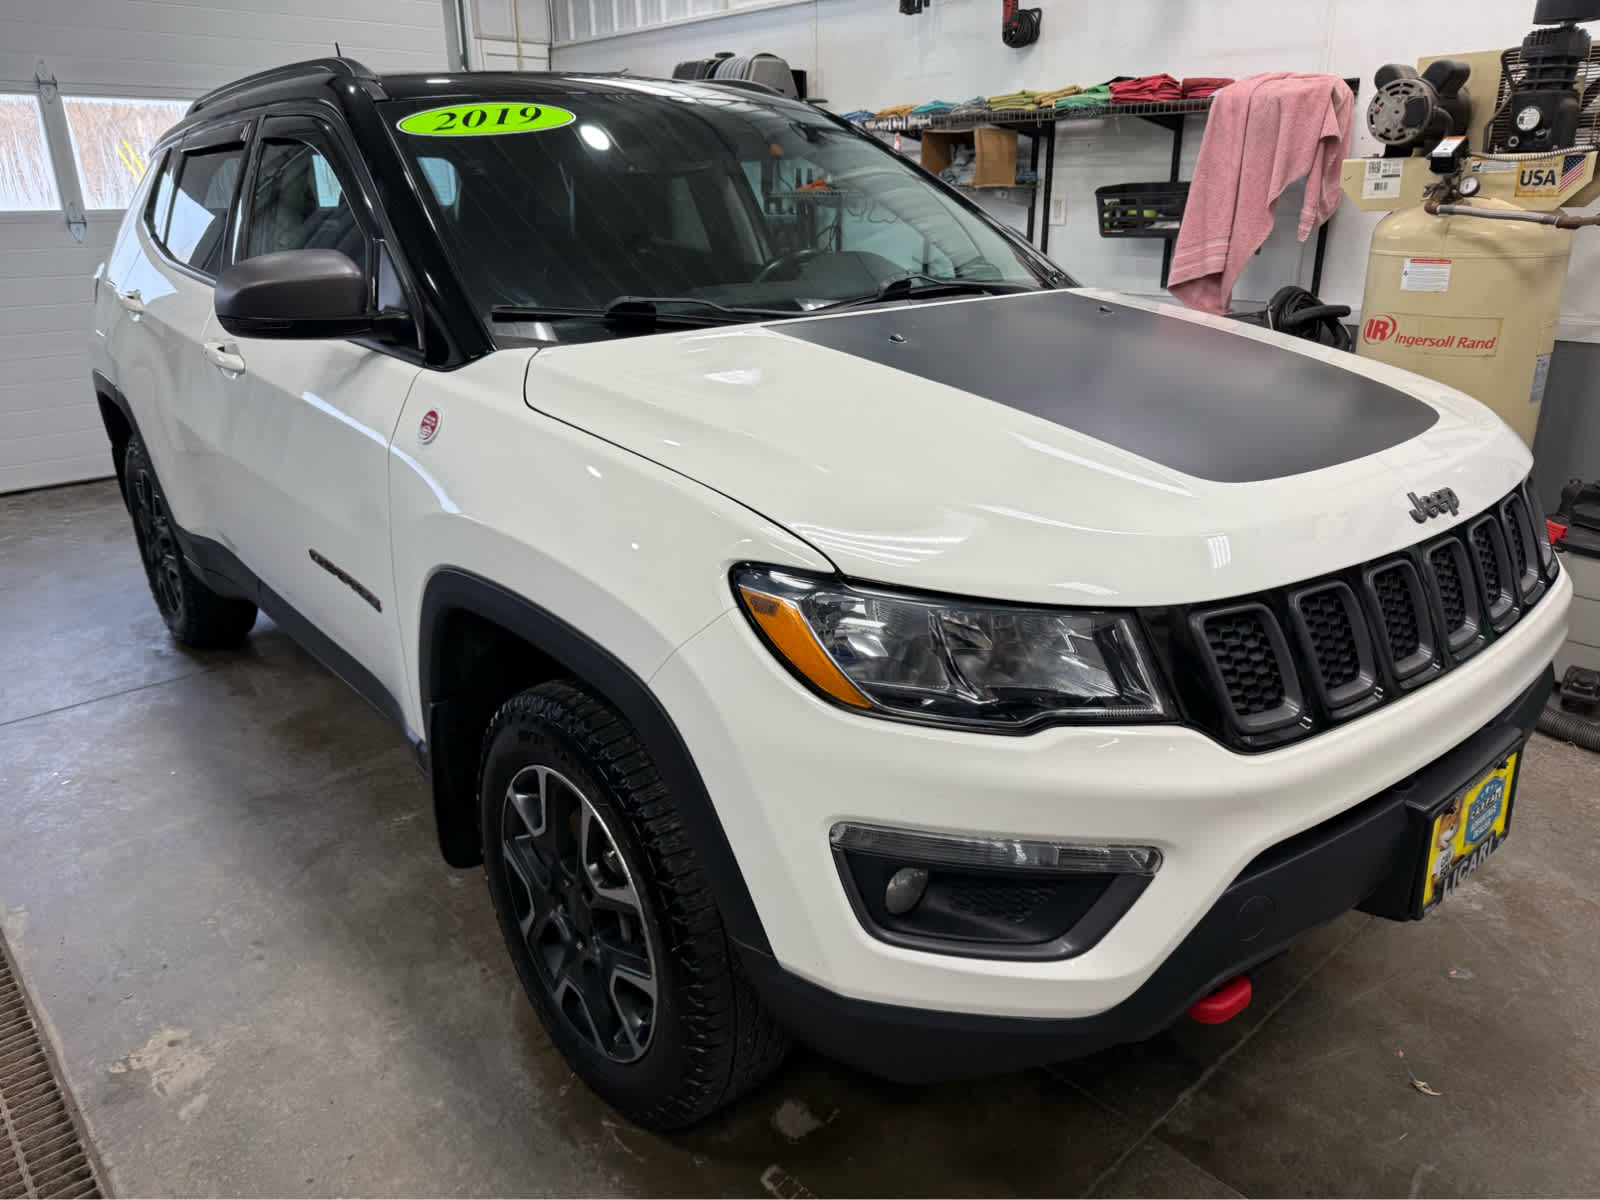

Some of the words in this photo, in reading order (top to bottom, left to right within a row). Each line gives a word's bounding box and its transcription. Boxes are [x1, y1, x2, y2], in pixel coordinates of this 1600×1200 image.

[432, 107, 542, 131] 2019
[1519, 169, 1556, 186] USA
[1366, 318, 1390, 342] IR
[1394, 332, 1455, 349] Ingersoll
[1455, 336, 1497, 350] Rand
[1407, 487, 1460, 524] Jeep
